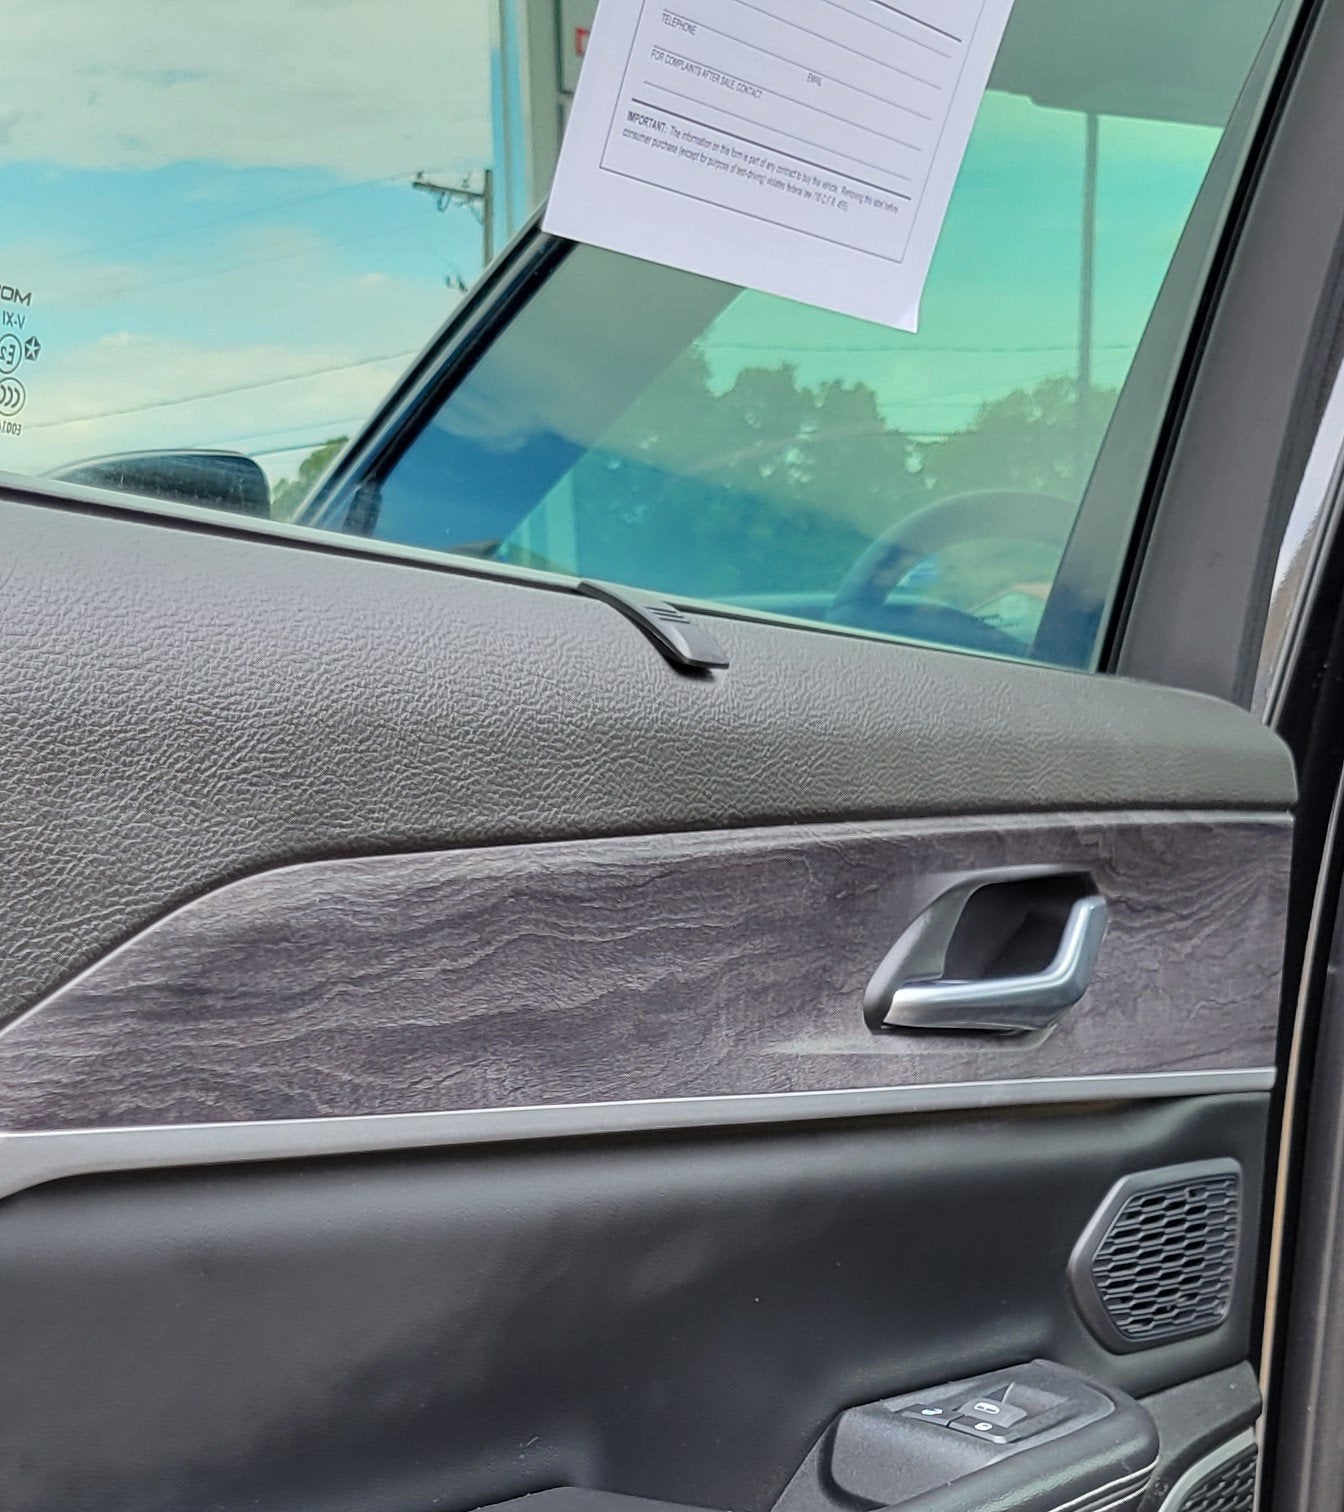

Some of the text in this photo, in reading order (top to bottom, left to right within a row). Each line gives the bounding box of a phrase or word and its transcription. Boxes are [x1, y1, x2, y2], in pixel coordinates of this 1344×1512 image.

[662, 13, 697, 35] TELEPHONE
[651, 49, 664, 60] FOR
[665, 55, 701, 76] COMPLAINTS
[702, 69, 720, 82] AFTER
[627, 111, 668, 132] IMPORTANT:
[670, 125, 681, 138] The
